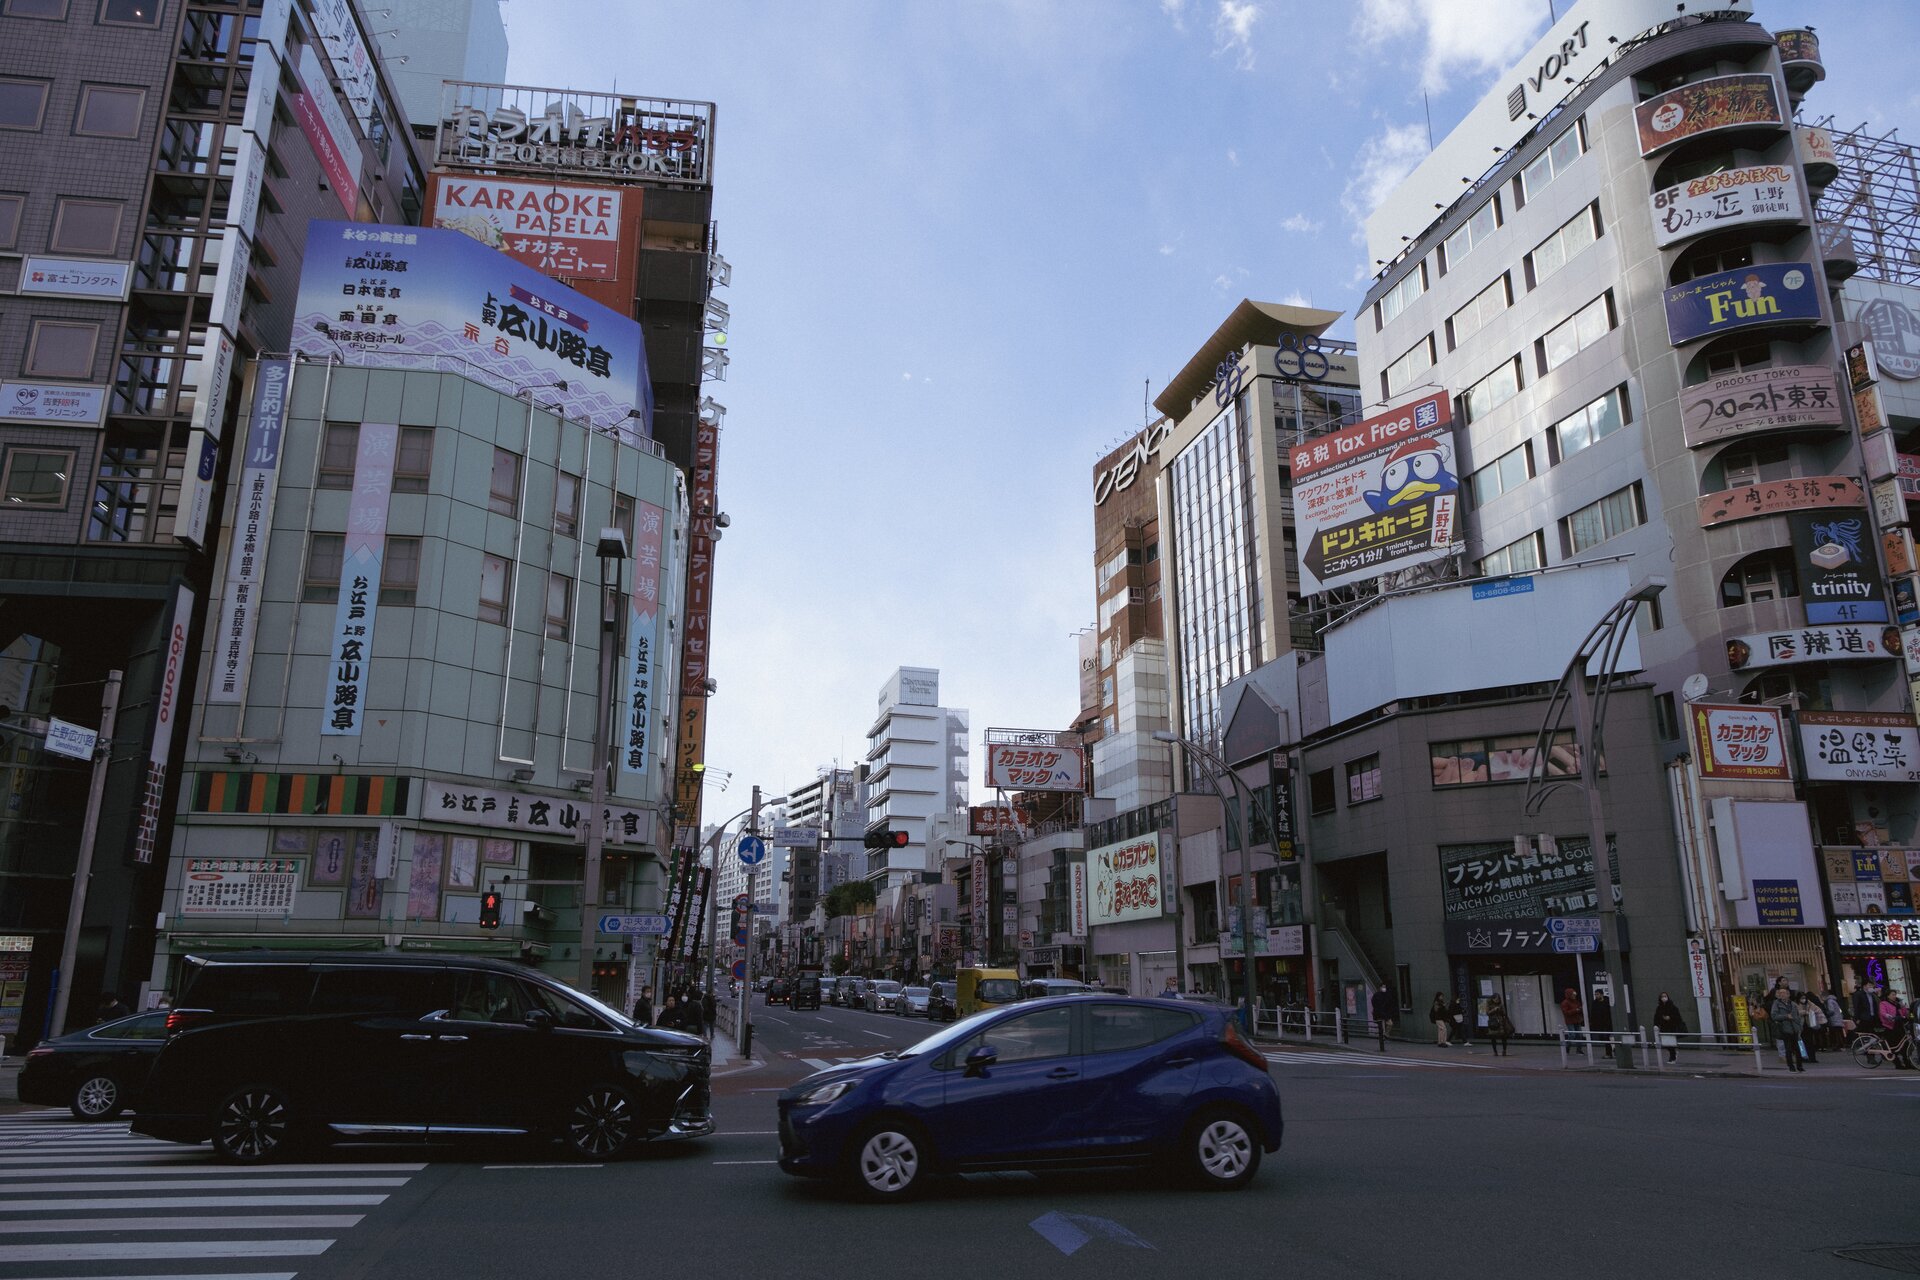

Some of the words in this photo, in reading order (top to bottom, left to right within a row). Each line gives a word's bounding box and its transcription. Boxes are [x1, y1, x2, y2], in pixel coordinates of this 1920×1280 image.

[1527, 20, 1591, 93] VORT
[452, 100, 612, 148] カラオケ
[614, 125, 695, 151] パセラ
[1687, 166, 1791, 198] 全身もみほぐし
[1751, 186, 1784, 202] 上野
[444, 184, 613, 218] KARAOKE
[1654, 186, 1680, 210] 8F
[1752, 202, 1790, 215] 御徒町
[515, 212, 610, 236] PASELA
[1662, 191, 1743, 234] もみの匠
[513, 238, 578, 256] オカチで
[539, 255, 607, 272] ハニトー
[47, 273, 118, 287] 富士コンタクト
[342, 284, 401, 299] 日本橋亭
[1786, 275, 1802, 285] 7F
[339, 311, 398, 326] 両国亭
[481, 291, 498, 326] 上野
[529, 294, 569, 321] お江戸
[1706, 290, 1782, 325] Fun
[328, 329, 405, 344] 新宿永谷ホール
[463, 321, 511, 356] 永谷
[701, 253, 731, 427] カラオケ
[1716, 374, 1758, 390] PROOST
[1764, 369, 1800, 379] TOKYO
[42, 397, 80, 408] 吉野眼科
[46, 408, 87, 417] クリニック
[253, 366, 288, 463] 多目的ホール
[1417, 404, 1436, 427] 薬
[1295, 443, 1330, 471] 免税
[1334, 432, 1366, 455] Tax
[1371, 418, 1412, 443] Free
[1297, 471, 1318, 484] Largest
[1320, 461, 1348, 477] selection
[1349, 458, 1356, 467] of
[1357, 450, 1377, 464] luxury
[1378, 443, 1397, 455] brand
[1399, 440, 1406, 448] in
[1407, 436, 1419, 444] the
[1421, 427, 1445, 440] region.
[356, 432, 393, 535] 演芸場
[1298, 469, 1367, 501] ワクワク・ドキドキ
[1745, 480, 1821, 505] 肉の奇跡
[1305, 507, 1330, 520] Exciting!
[1331, 501, 1347, 512] Open
[1348, 496, 1363, 507] until
[1319, 509, 1348, 523] midnight!
[1434, 498, 1450, 543] 上野店
[639, 510, 660, 602] 演芸場
[1390, 546, 1407, 556] from
[1408, 541, 1428, 554] here!
[1324, 548, 1383, 574] ここから1分!!
[347, 575, 369, 619] お江戸
[1811, 580, 1871, 598] trinity
[1837, 604, 1858, 619] 4F
[1897, 601, 1916, 611] trinity
[343, 625, 366, 637] 上野
[637, 636, 649, 675] お江戸
[686, 615, 707, 678] パセラ
[160, 623, 184, 723] docomo
[634, 678, 648, 689] 上野
[901, 677, 937, 687] CENTURION
[909, 686, 931, 694] HOTEL
[50, 725, 94, 747] 上野広小路
[1716, 723, 1773, 742] カラオケ
[55, 740, 85, 754] Uenohirokoji
[998, 749, 1061, 767] カラオケ
[1727, 743, 1768, 761] マック
[1819, 728, 1906, 768] 温野菜
[1007, 768, 1052, 784] マック
[1845, 768, 1887, 778] ONYASAI
[441, 792, 496, 813] お江戸
[507, 796, 519, 823] 上野
[528, 800, 640, 835] 広小亭
[776, 830, 816, 839] 上野広小路
[1118, 843, 1150, 870] カラオケ
[1856, 859, 1876, 871] Fun
[975, 859, 983, 908] カラオケマック
[1114, 874, 1158, 916] まねきねこ
[1447, 898, 1482, 914] WATCH
[1485, 888, 1529, 905] LIQUEUR
[624, 917, 662, 927] 中央通り
